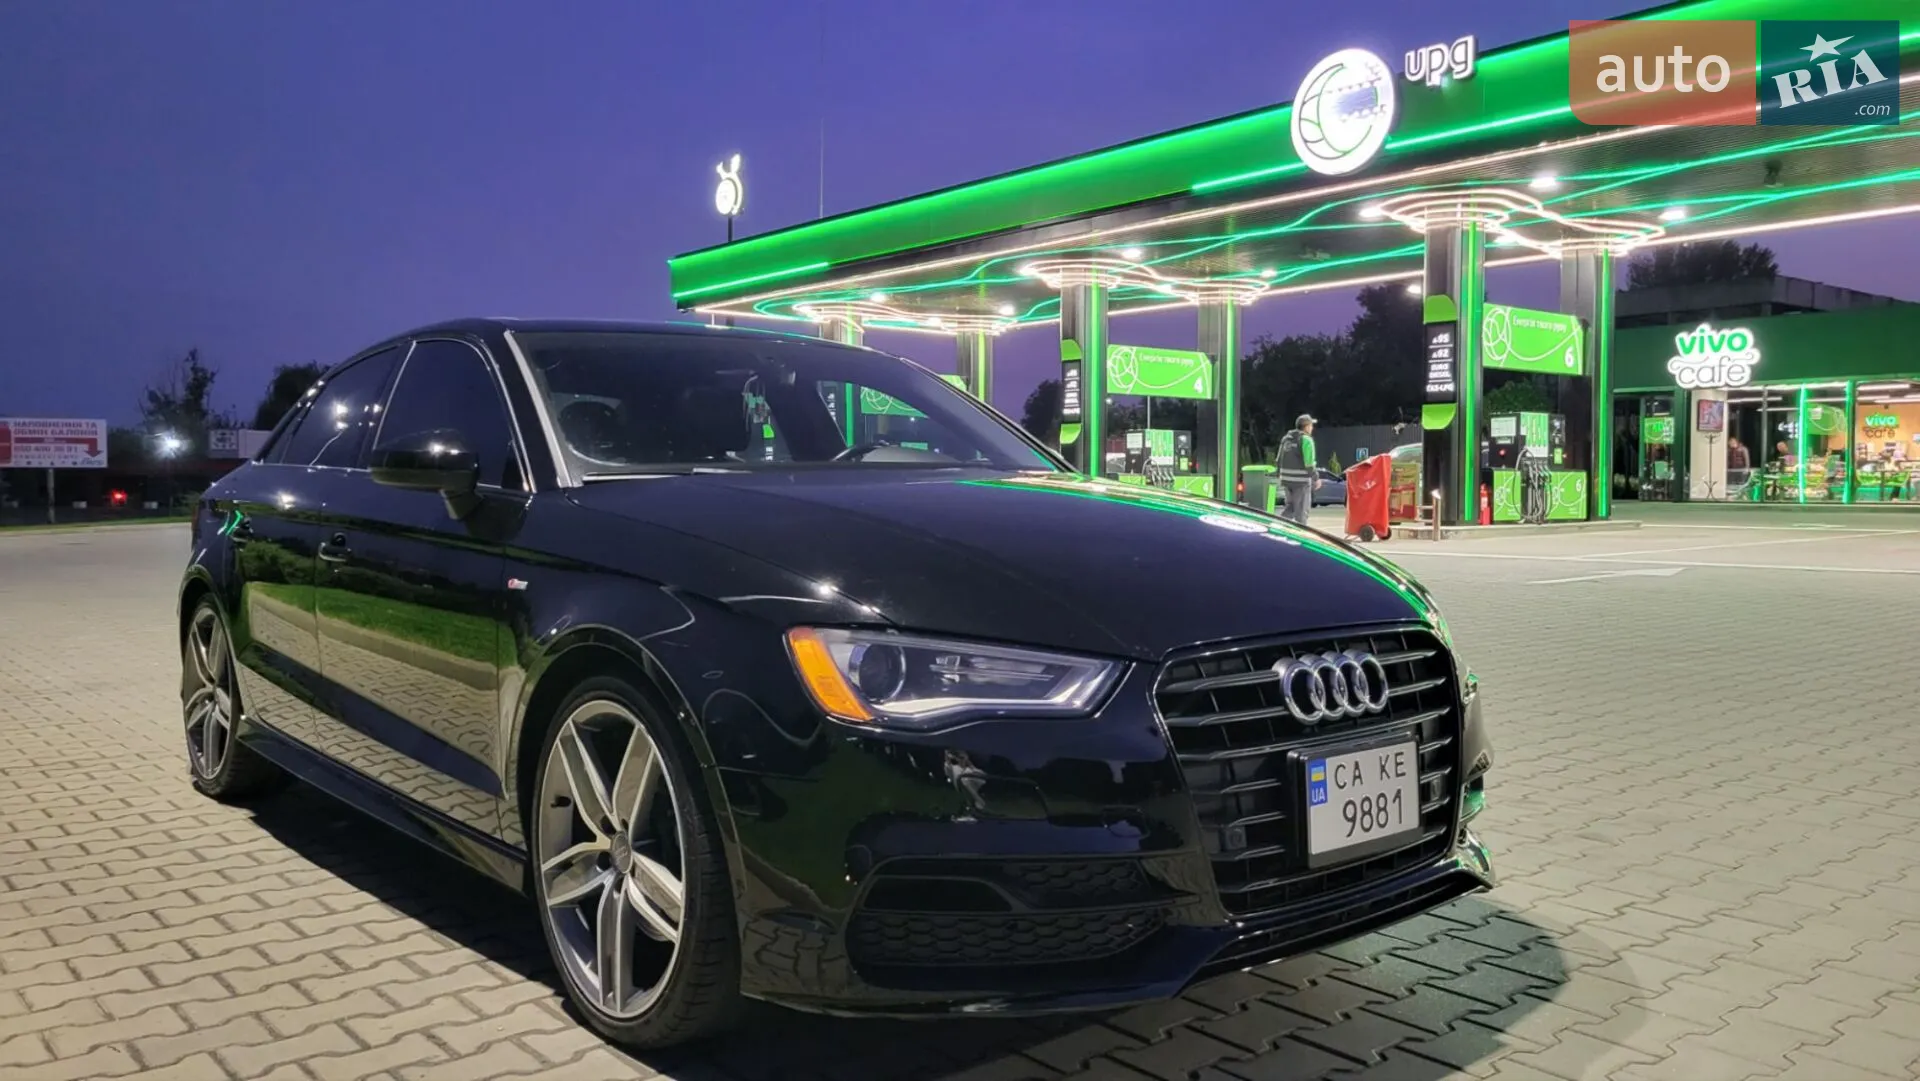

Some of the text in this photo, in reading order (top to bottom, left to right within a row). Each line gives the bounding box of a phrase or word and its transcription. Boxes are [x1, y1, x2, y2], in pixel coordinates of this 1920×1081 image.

[1405, 35, 1475, 87] upg
[1678, 329, 1748, 355] vivo
[1564, 345, 1574, 368] 6
[1677, 356, 1748, 385] cafe
[1194, 377, 1203, 394] 4
[1865, 413, 1896, 427] vivo
[1334, 751, 1406, 790] CA KE
[1311, 787, 1326, 803] UA
[1342, 788, 1402, 838] 9881
